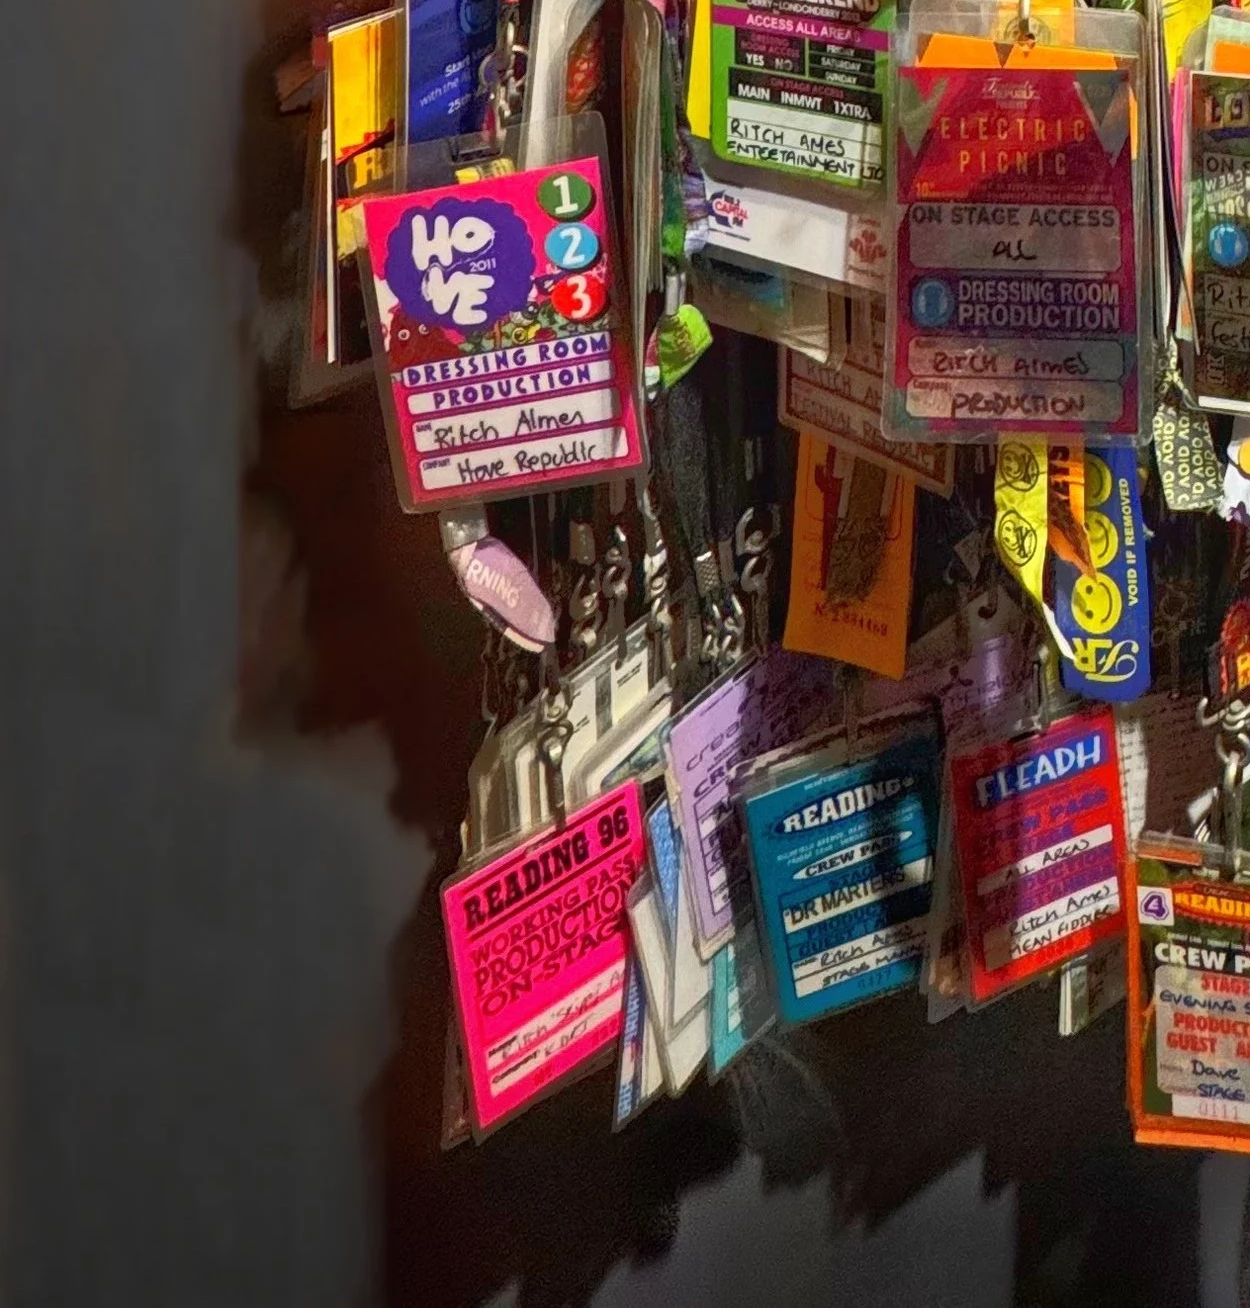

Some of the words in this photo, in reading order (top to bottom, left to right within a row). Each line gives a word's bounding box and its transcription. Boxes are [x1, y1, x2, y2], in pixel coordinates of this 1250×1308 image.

[738, 84, 772, 102] MAIN
[834, 101, 871, 121] 1XTRA
[939, 118, 1086, 141] ELECTRIC
[959, 150, 1069, 174] PICNIC
[912, 207, 940, 225] ON
[947, 207, 1022, 225] STAGE
[1029, 208, 1115, 227] ACCESS
[469, 257, 496, 272] 2011
[958, 281, 1055, 302] DRESSING
[1060, 282, 1119, 304] ROOM
[958, 305, 1120, 330] PRODUCTION
[407, 345, 533, 386] DRESSING
[538, 333, 609, 363] ROOM
[433, 365, 591, 411] PRODUCTION
[1118, 477, 1134, 550] REMOVED
[1125, 553, 1135, 565] IF
[1126, 569, 1138, 605] VOID
[977, 735, 1101, 807] FLEADH
[468, 835, 589, 926] READING
[600, 812, 628, 843] 96
[475, 878, 632, 992] PRODUCTION
[1155, 944, 1226, 970] CREW
[1201, 975, 1250, 997] STAGE
[1167, 1032, 1216, 1054] GUEST
